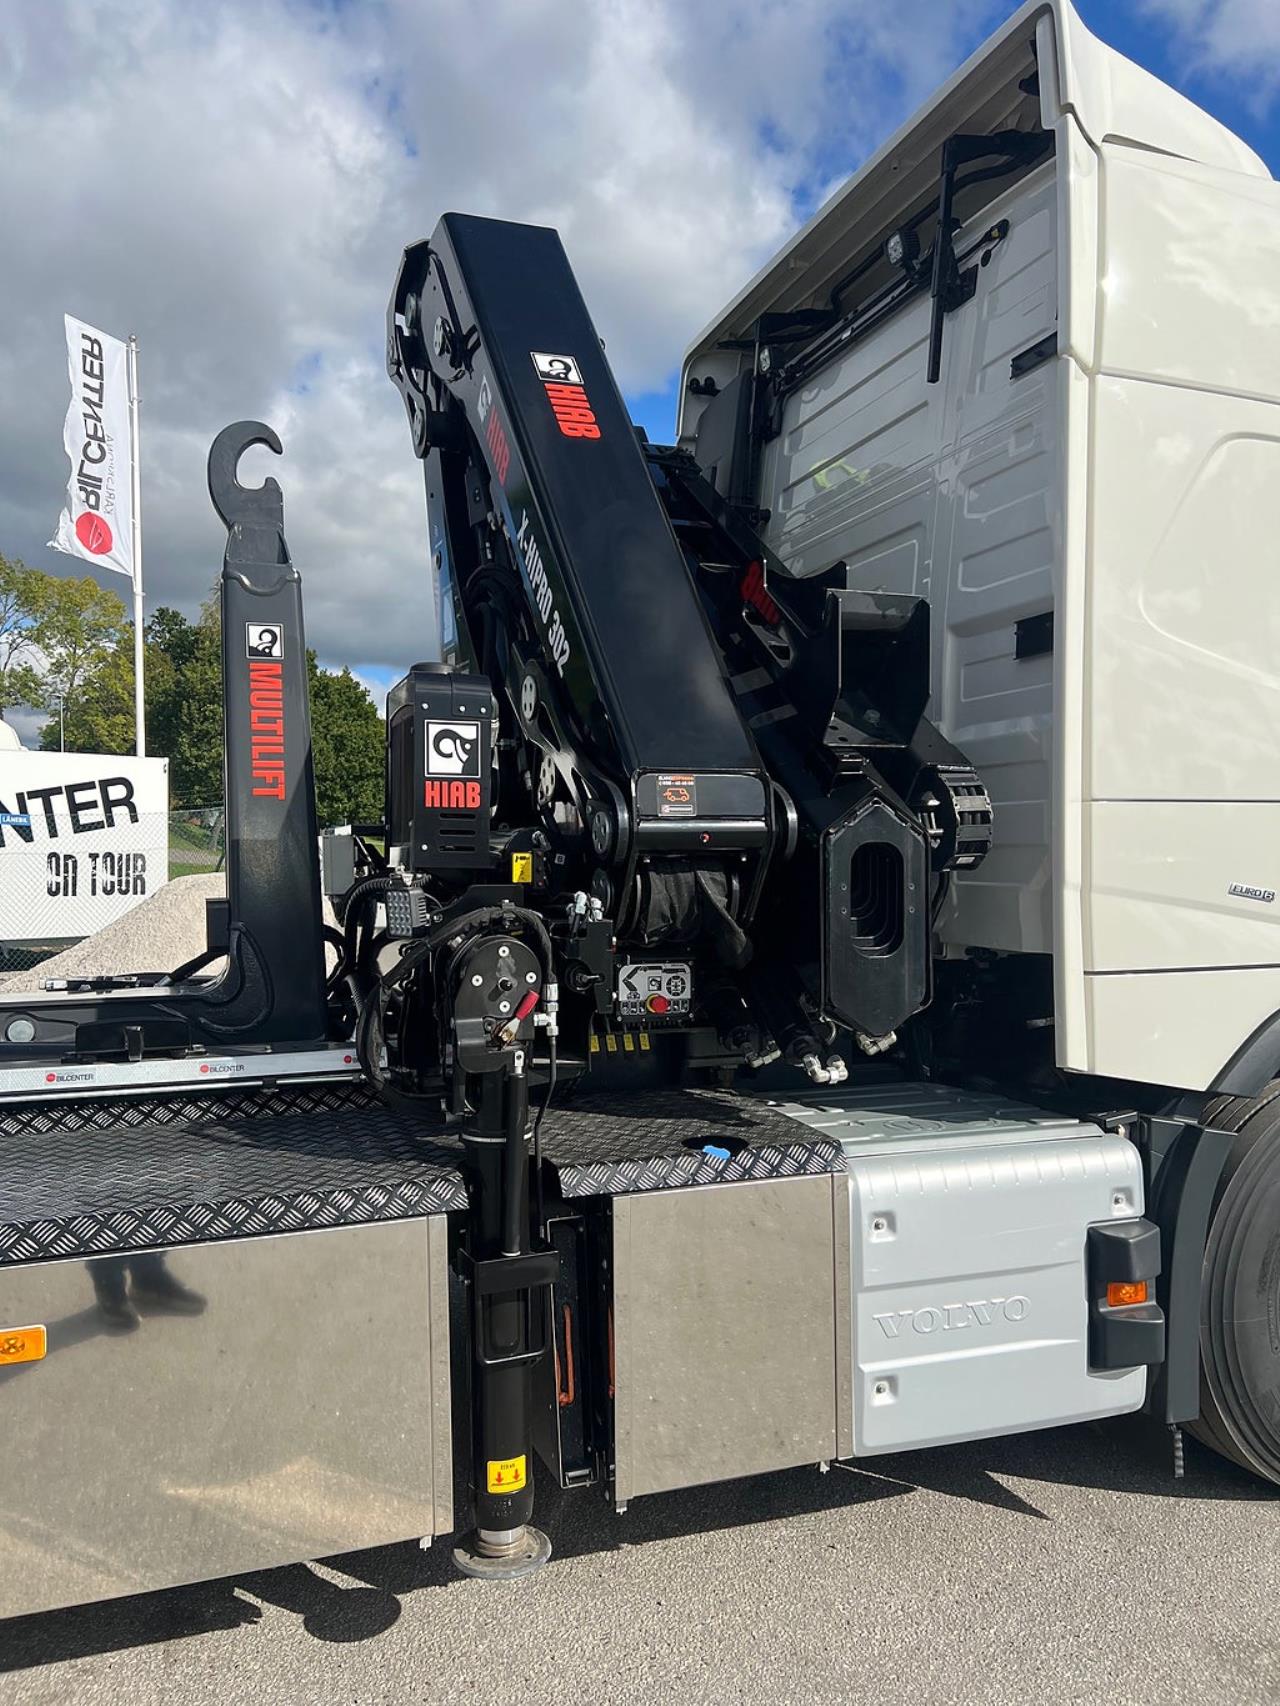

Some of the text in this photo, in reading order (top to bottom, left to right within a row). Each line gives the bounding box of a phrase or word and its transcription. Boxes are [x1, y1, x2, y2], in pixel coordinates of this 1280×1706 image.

[544, 383, 601, 439] HIAB
[486, 405, 510, 487] HIAB
[517, 508, 571, 679] X-HIPRO 302
[249, 662, 287, 801] MULTILIFT
[425, 781, 481, 809] HIAB
[46, 851, 147, 898] ON TOUR
[1233, 884, 1262, 897] EURO
[56, 1073, 94, 1082] BILCENTER
[210, 1064, 245, 1073] BILCENTER
[872, 1295, 1032, 1339] VOLVO
